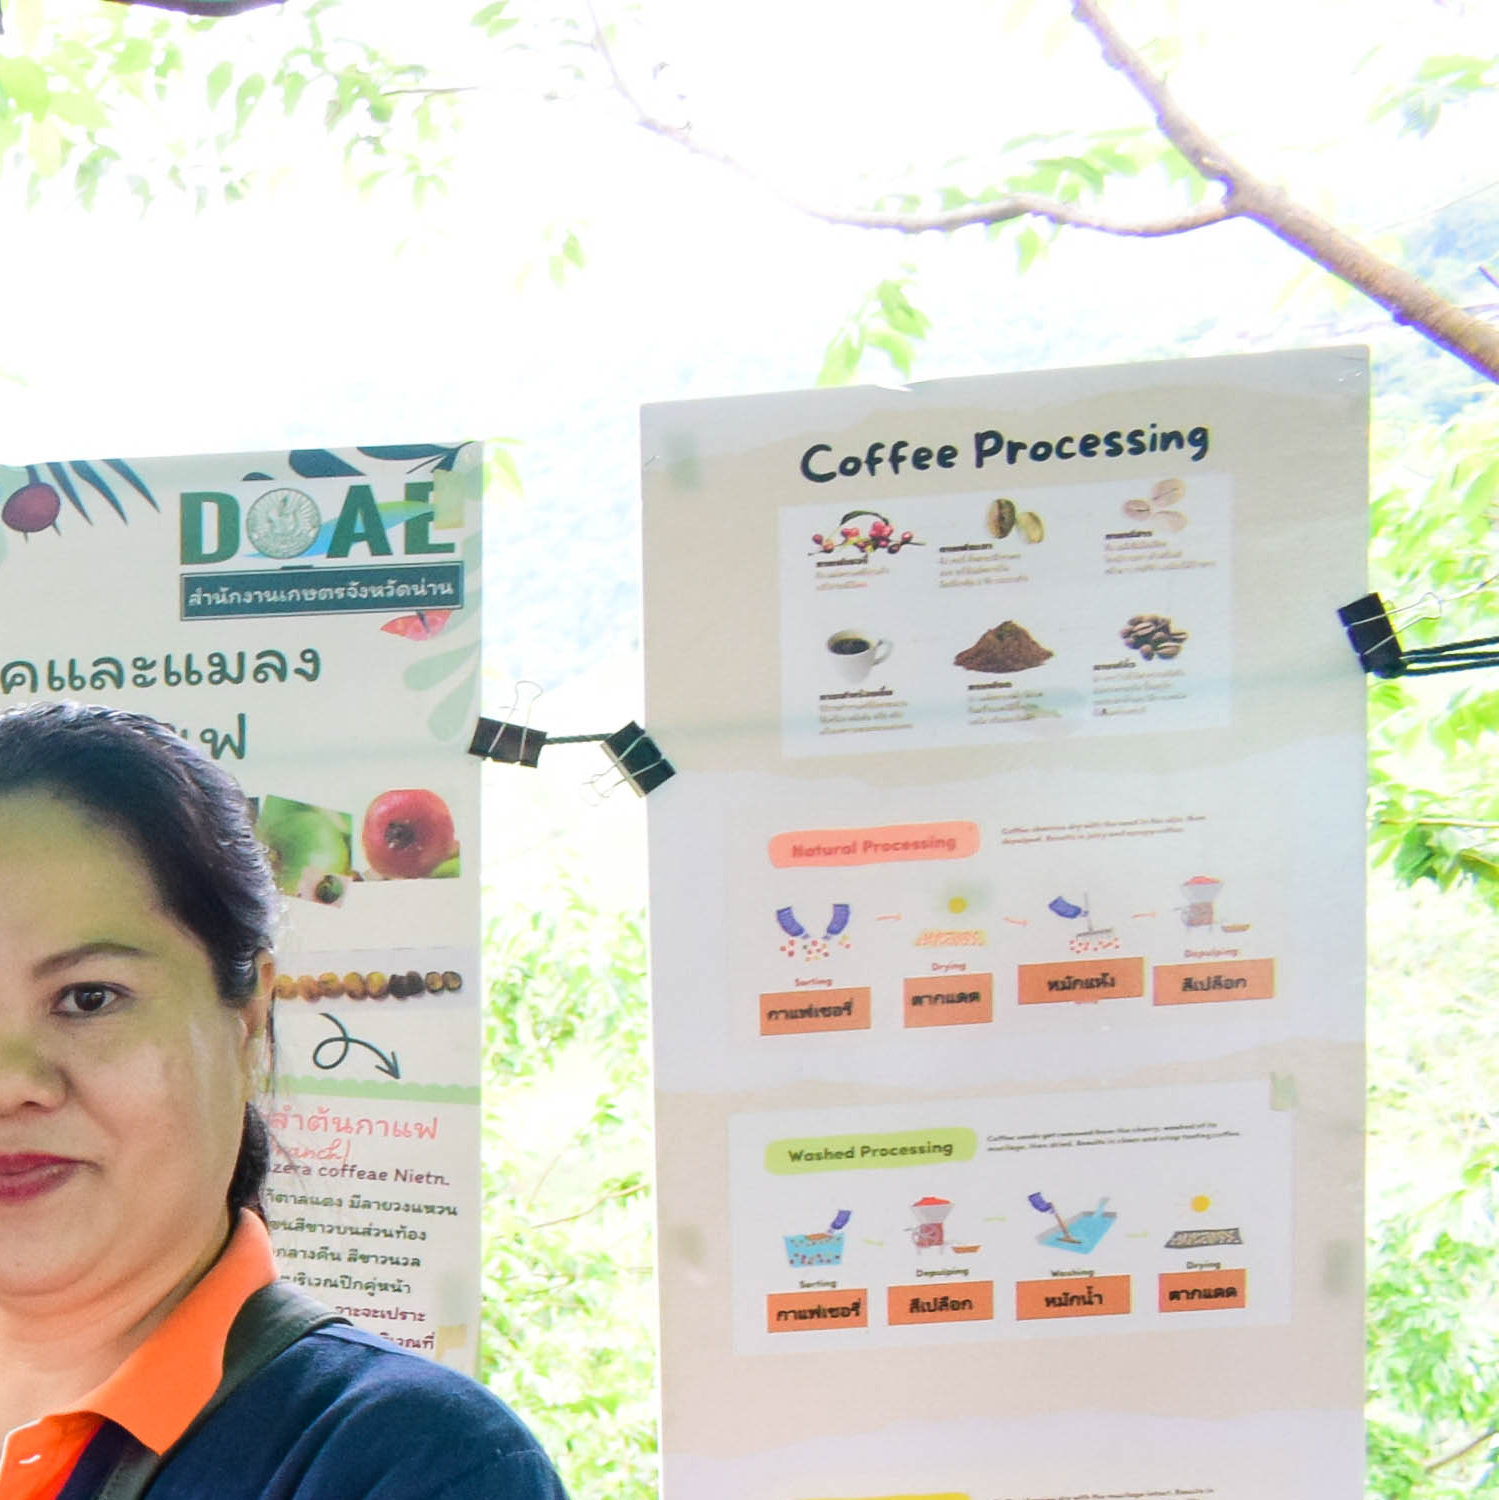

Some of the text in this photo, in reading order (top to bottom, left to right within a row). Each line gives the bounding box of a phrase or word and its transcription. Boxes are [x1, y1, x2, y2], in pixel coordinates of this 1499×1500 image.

[801, 421, 1212, 485] Coffee Processing
[187, 578, 455, 609] สำนักงานเกษตรจังหวัดน่าน
[791, 832, 958, 859] Natural Processing
[786, 1137, 955, 1163] Washed Processing
[317, 1163, 452, 1188] coffeae Nietn.
[908, 1292, 974, 1317] สีเปลือก
[1168, 1282, 1238, 1304] ตากแดด
